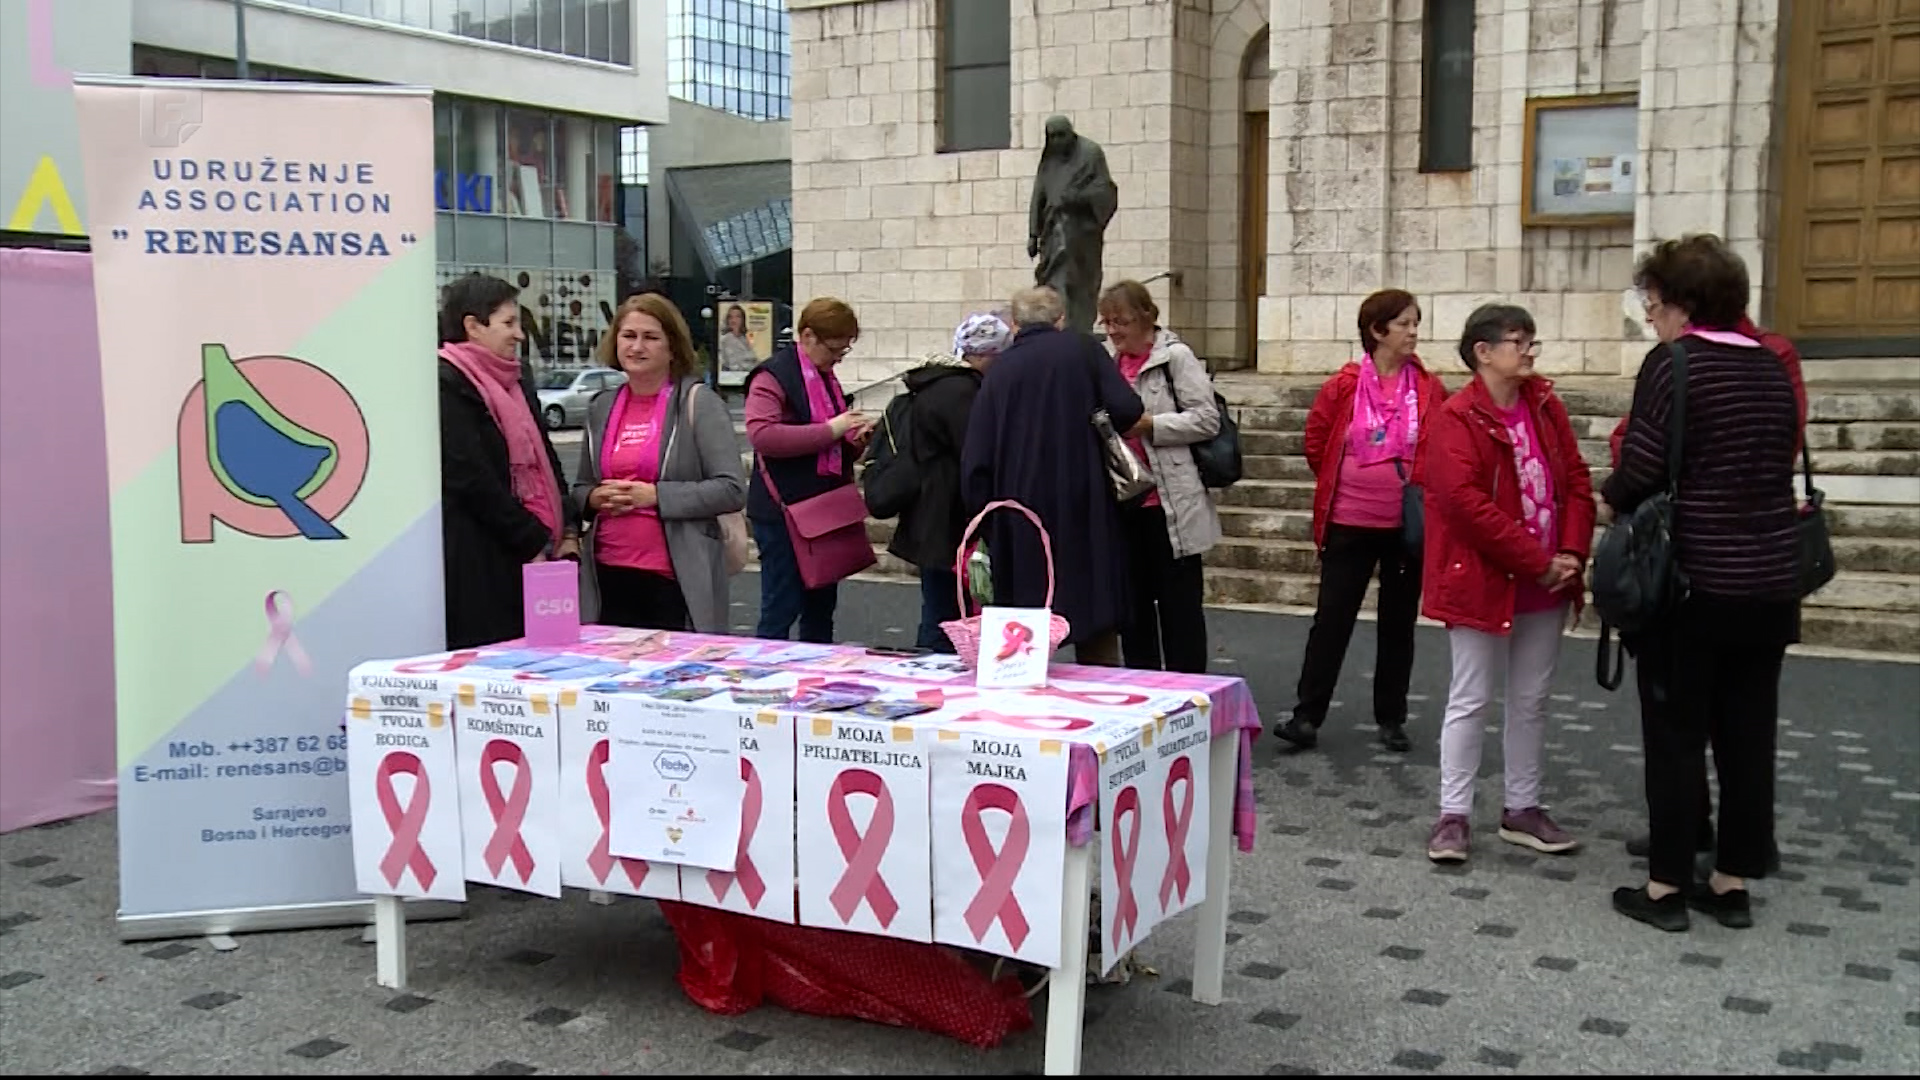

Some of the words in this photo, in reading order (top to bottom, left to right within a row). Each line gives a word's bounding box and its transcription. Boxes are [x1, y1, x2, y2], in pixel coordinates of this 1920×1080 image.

[153, 157, 374, 184] UDRUŽENJE
[138, 189, 391, 214] ASSOCIATION
[145, 229, 391, 256] RENESANSA
[482, 701, 526, 717] TVOJA
[380, 714, 424, 729] TVOJA
[466, 718, 544, 738] KOMŠINICA
[375, 733, 430, 748] RODICA
[837, 726, 885, 744] MOJA
[169, 741, 221, 759] Mob.
[296, 735, 320, 752] 62
[326, 734, 347, 750] 68
[972, 739, 1022, 758] MOJA
[660, 757, 690, 772] Roche
[803, 744, 922, 769] PRIJATELJICA
[134, 764, 209, 782] E-mail:
[216, 756, 347, 778] renesans@b
[966, 760, 1027, 781] MAJKA
[252, 806, 327, 822] Sarajevo
[201, 828, 257, 842] Bosna
[272, 824, 351, 840] Hercegov
